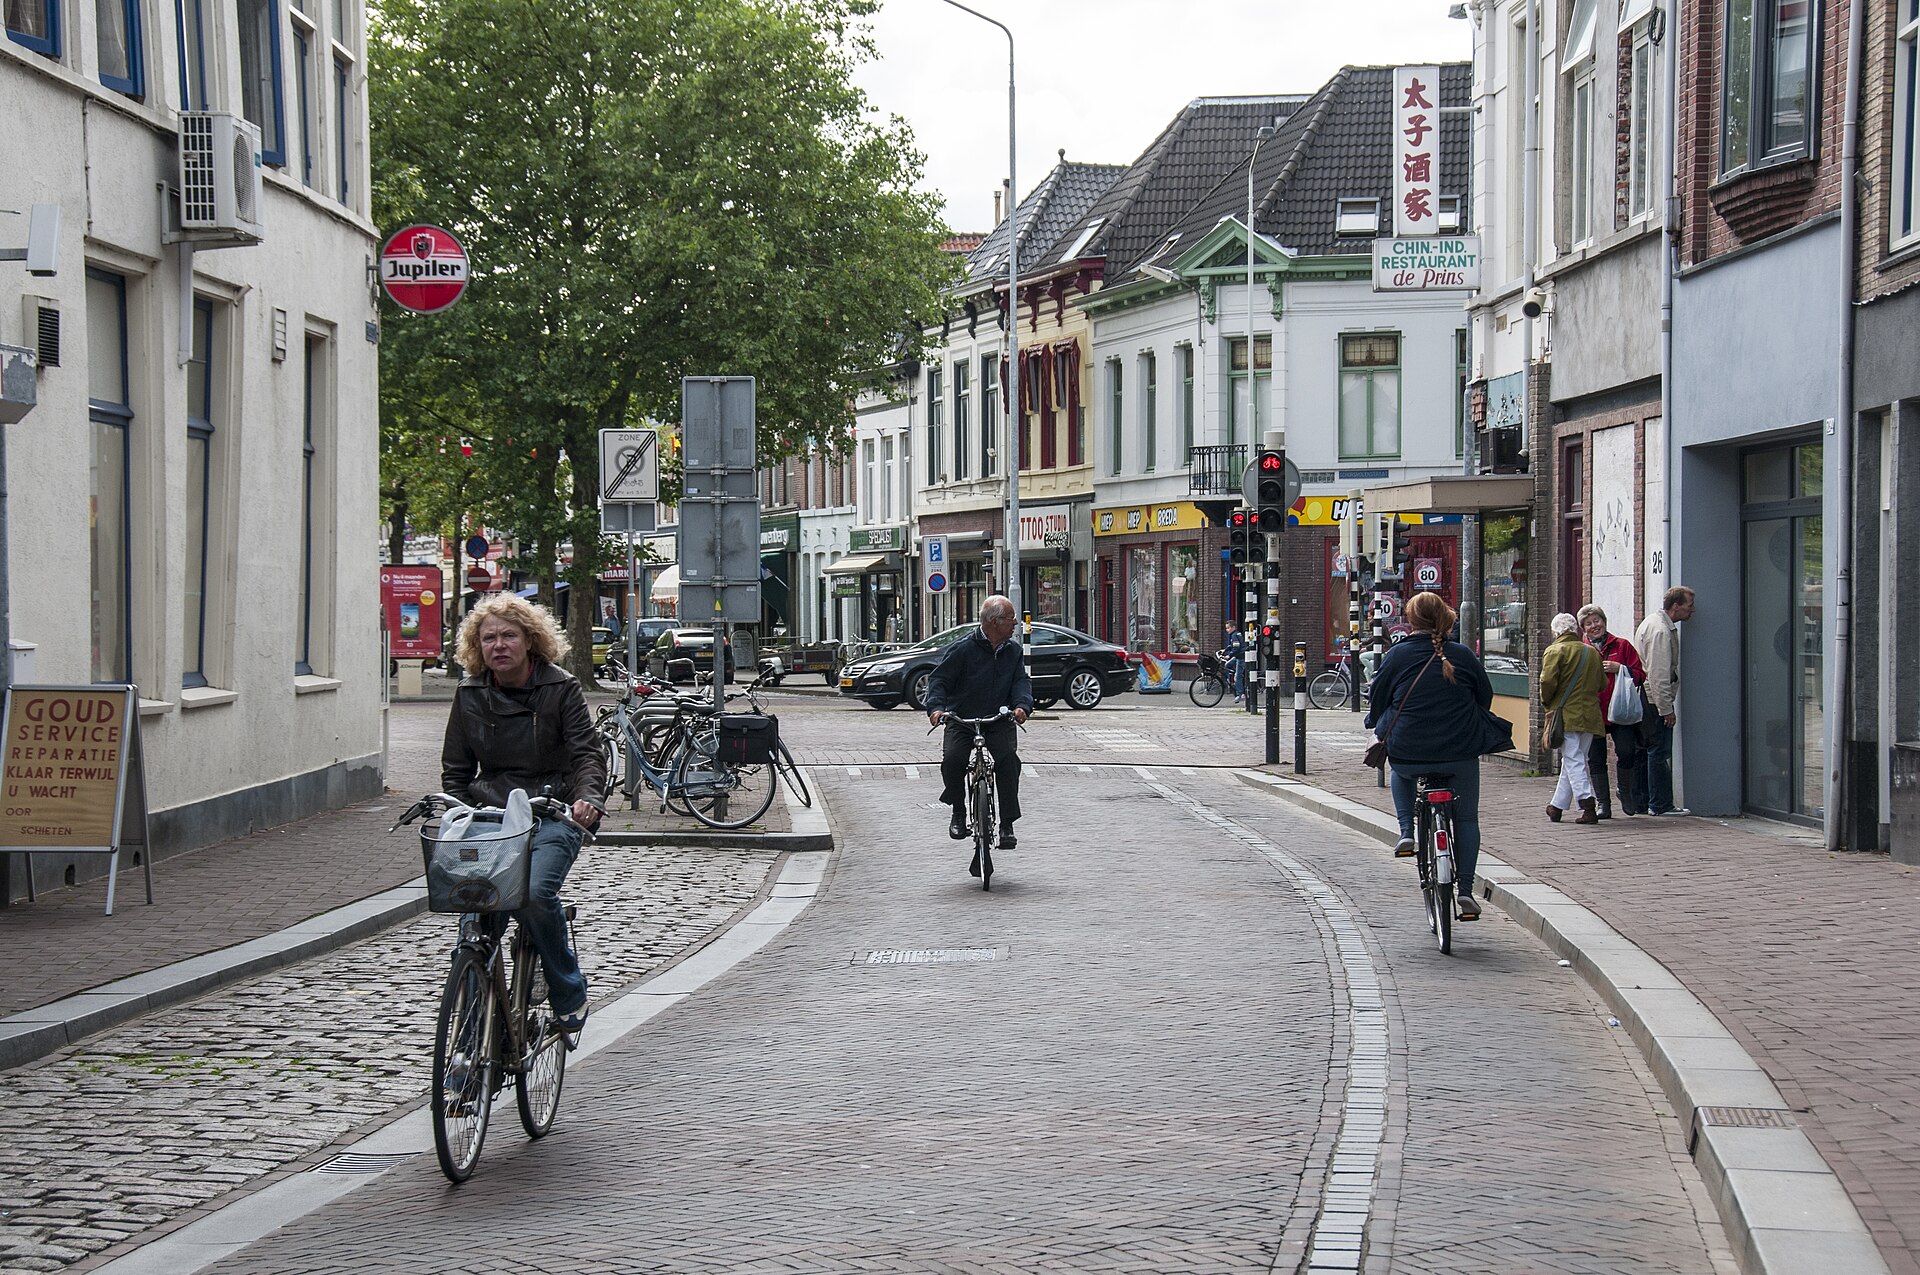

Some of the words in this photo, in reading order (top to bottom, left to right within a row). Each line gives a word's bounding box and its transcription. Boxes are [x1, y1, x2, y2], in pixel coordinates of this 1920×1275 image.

[1402, 77, 1433, 222] 太子酒家
[1393, 241, 1467, 254] CHIN.-IND.
[1381, 255, 1476, 269] RESTAURANT
[388, 260, 461, 280] Jupiler
[1393, 270, 1415, 286] de
[1422, 268, 1465, 288] Prins
[1100, 512, 1114, 532] HIEP
[1127, 509, 1141, 530] HIEP
[1157, 506, 1178, 528] BREDA
[1020, 516, 1044, 541] TTOO
[1045, 514, 1066, 532] STUDIO
[868, 529, 892, 545] SPECIALIST
[931, 544, 939, 554] P
[1652, 551, 1663, 574] 26
[1421, 570, 1435, 580] 80
[25, 698, 115, 723] GOUD
[18, 725, 119, 742] SERVICE
[12, 747, 116, 762] REPARATIE
[6, 766, 53, 779] KLAAR
[60, 767, 114, 780] TERWIJL
[8, 785, 18, 797] U
[29, 785, 77, 798] WACHT
[5, 807, 31, 816] OOR
[21, 826, 72, 835] SCHIETEN
